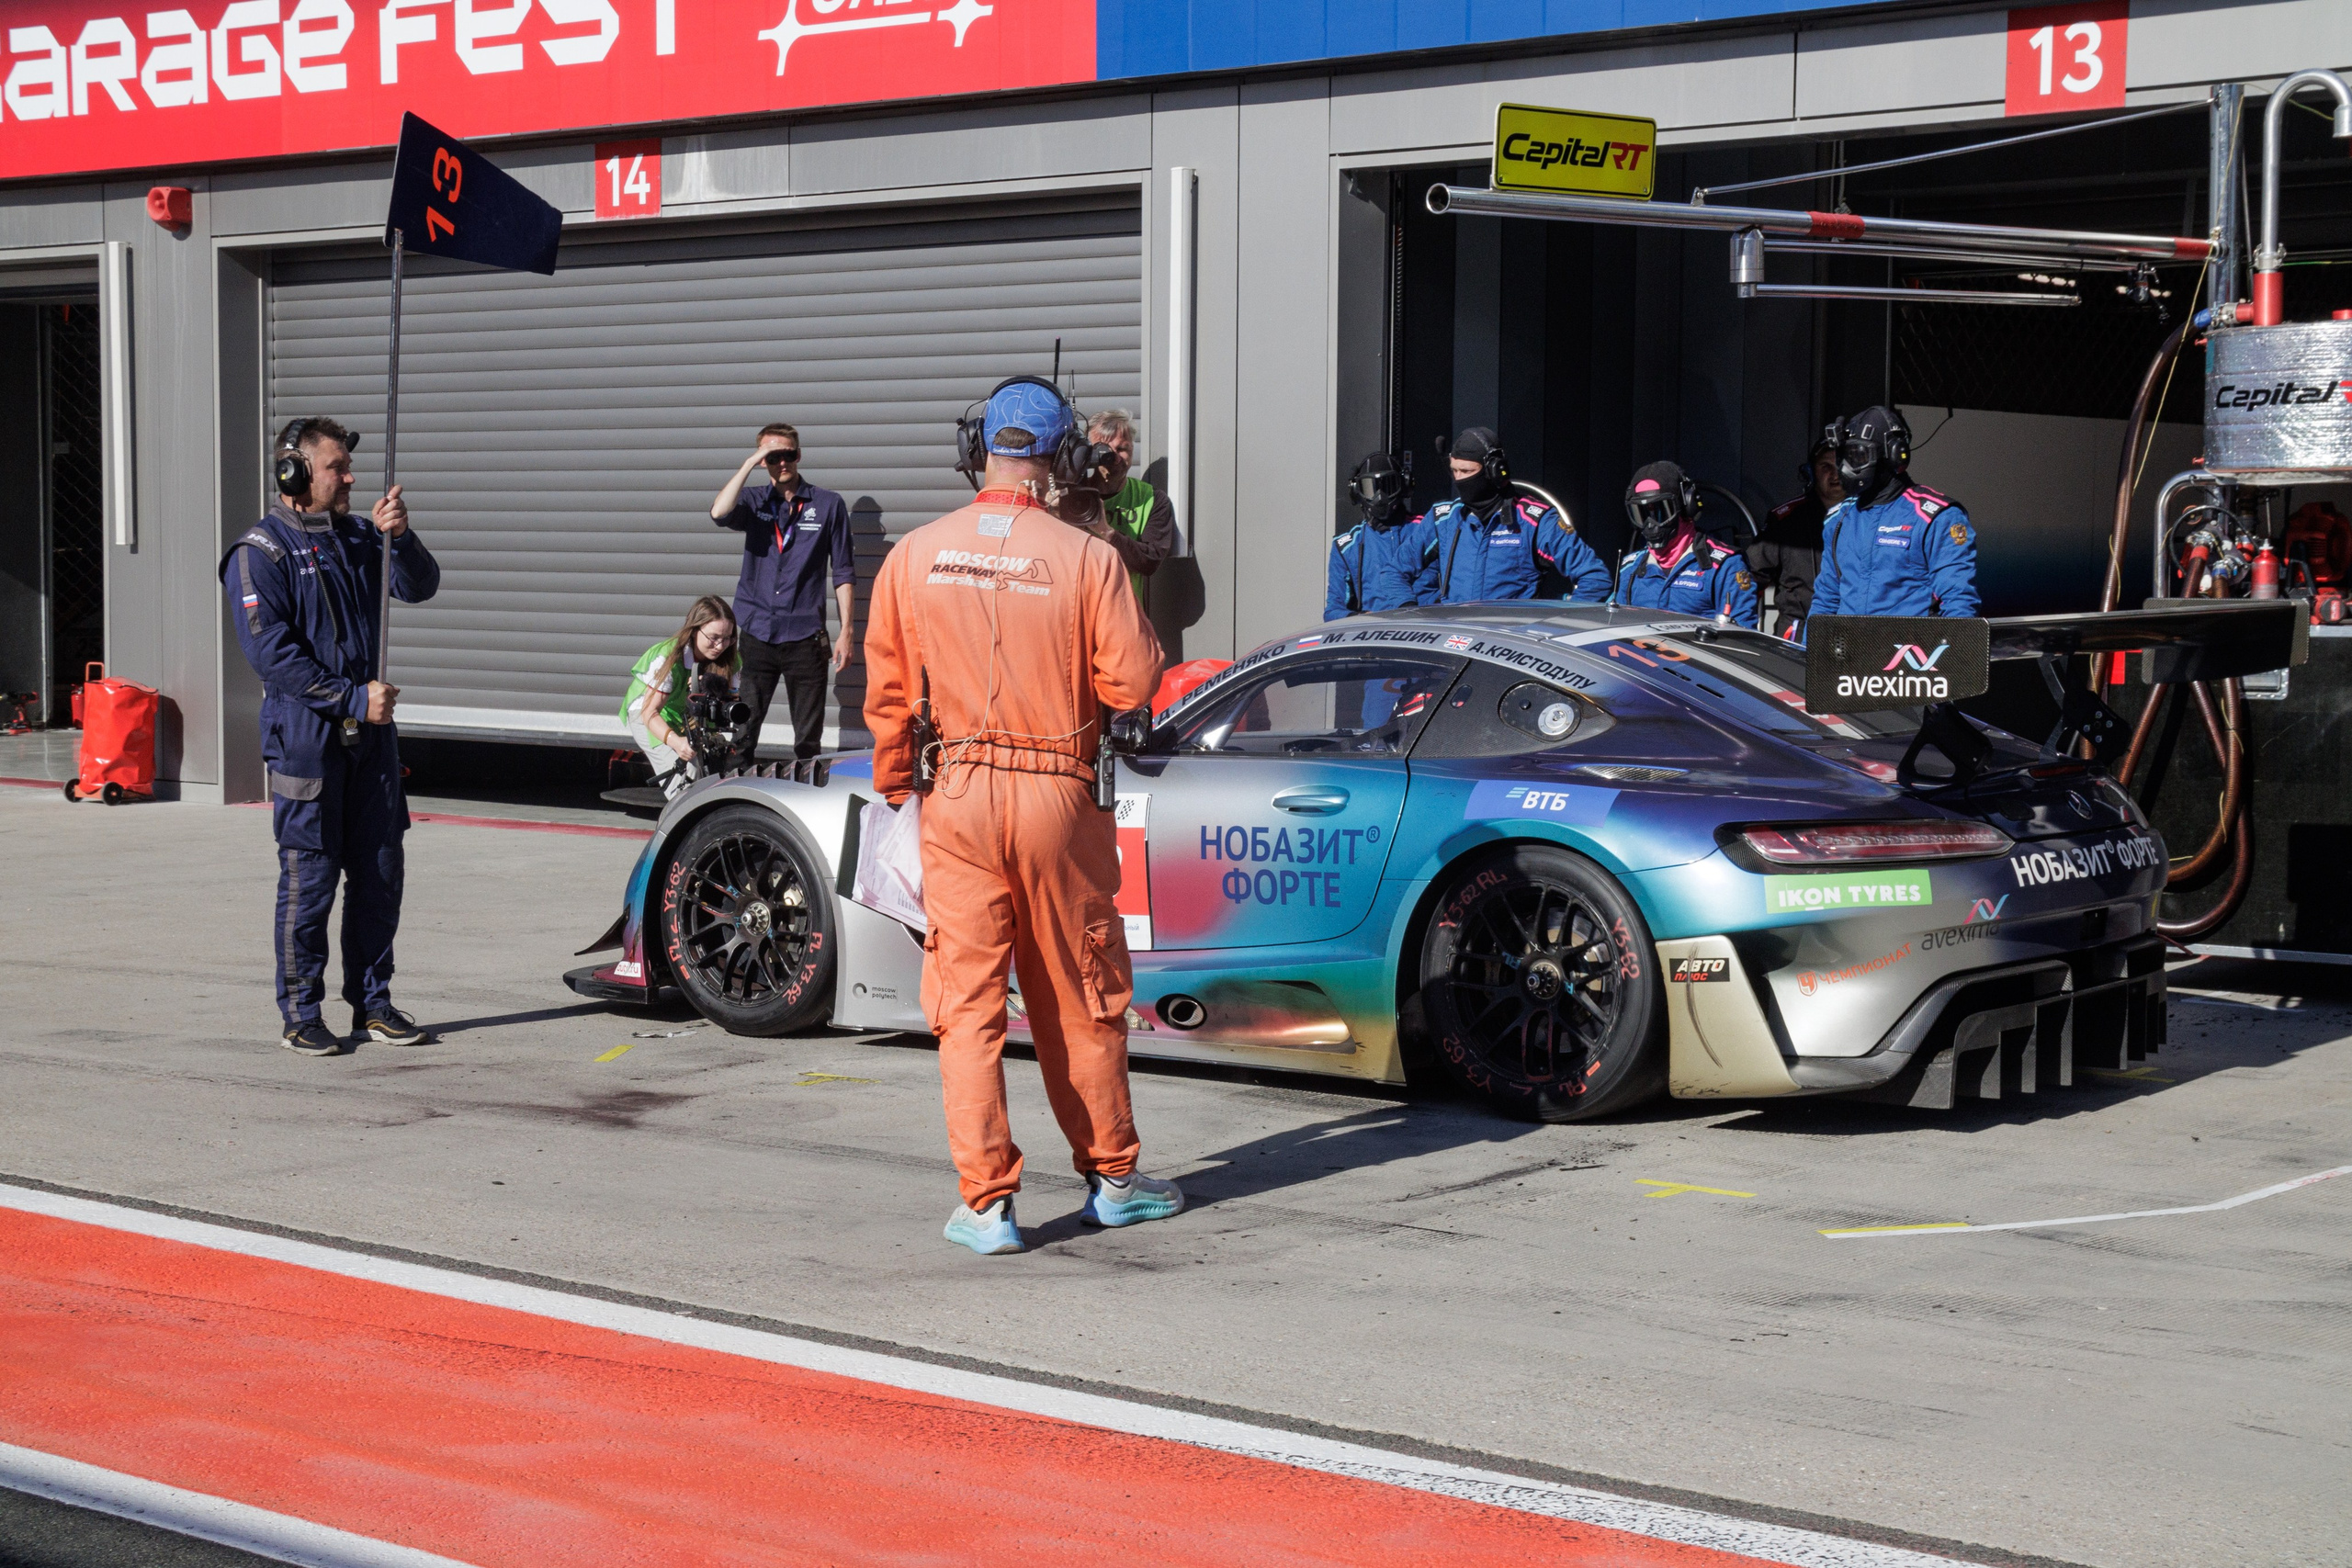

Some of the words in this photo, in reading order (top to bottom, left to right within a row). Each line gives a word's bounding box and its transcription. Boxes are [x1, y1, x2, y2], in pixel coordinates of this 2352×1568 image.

[2029, 20, 2104, 96] 13
[1502, 132, 1650, 172] CapitalRT
[605, 152, 651, 208] 14
[425, 147, 463, 243] 13
[931, 564, 997, 578] RACEWAY
[934, 549, 1032, 572] MOSCOW
[926, 573, 995, 590] Marshals
[1007, 581, 1050, 596] Team
[1353, 630, 1442, 645] АЛЕШИН
[1182, 644, 1286, 707] РЕМЕНЯКО
[1838, 670, 1949, 698] avexima
[1521, 791, 1570, 811] ВТБ
[2116, 837, 2159, 871] ФОРТЕ
[1222, 867, 1341, 908] ФОРТЕ
[1778, 886, 1841, 910] IKON
[1848, 885, 1921, 902] TYRES
[1921, 922, 2000, 951] avexima
[1677, 959, 1725, 973] АВТО
[1819, 942, 1912, 986] ЧЕМПИОНАТ
